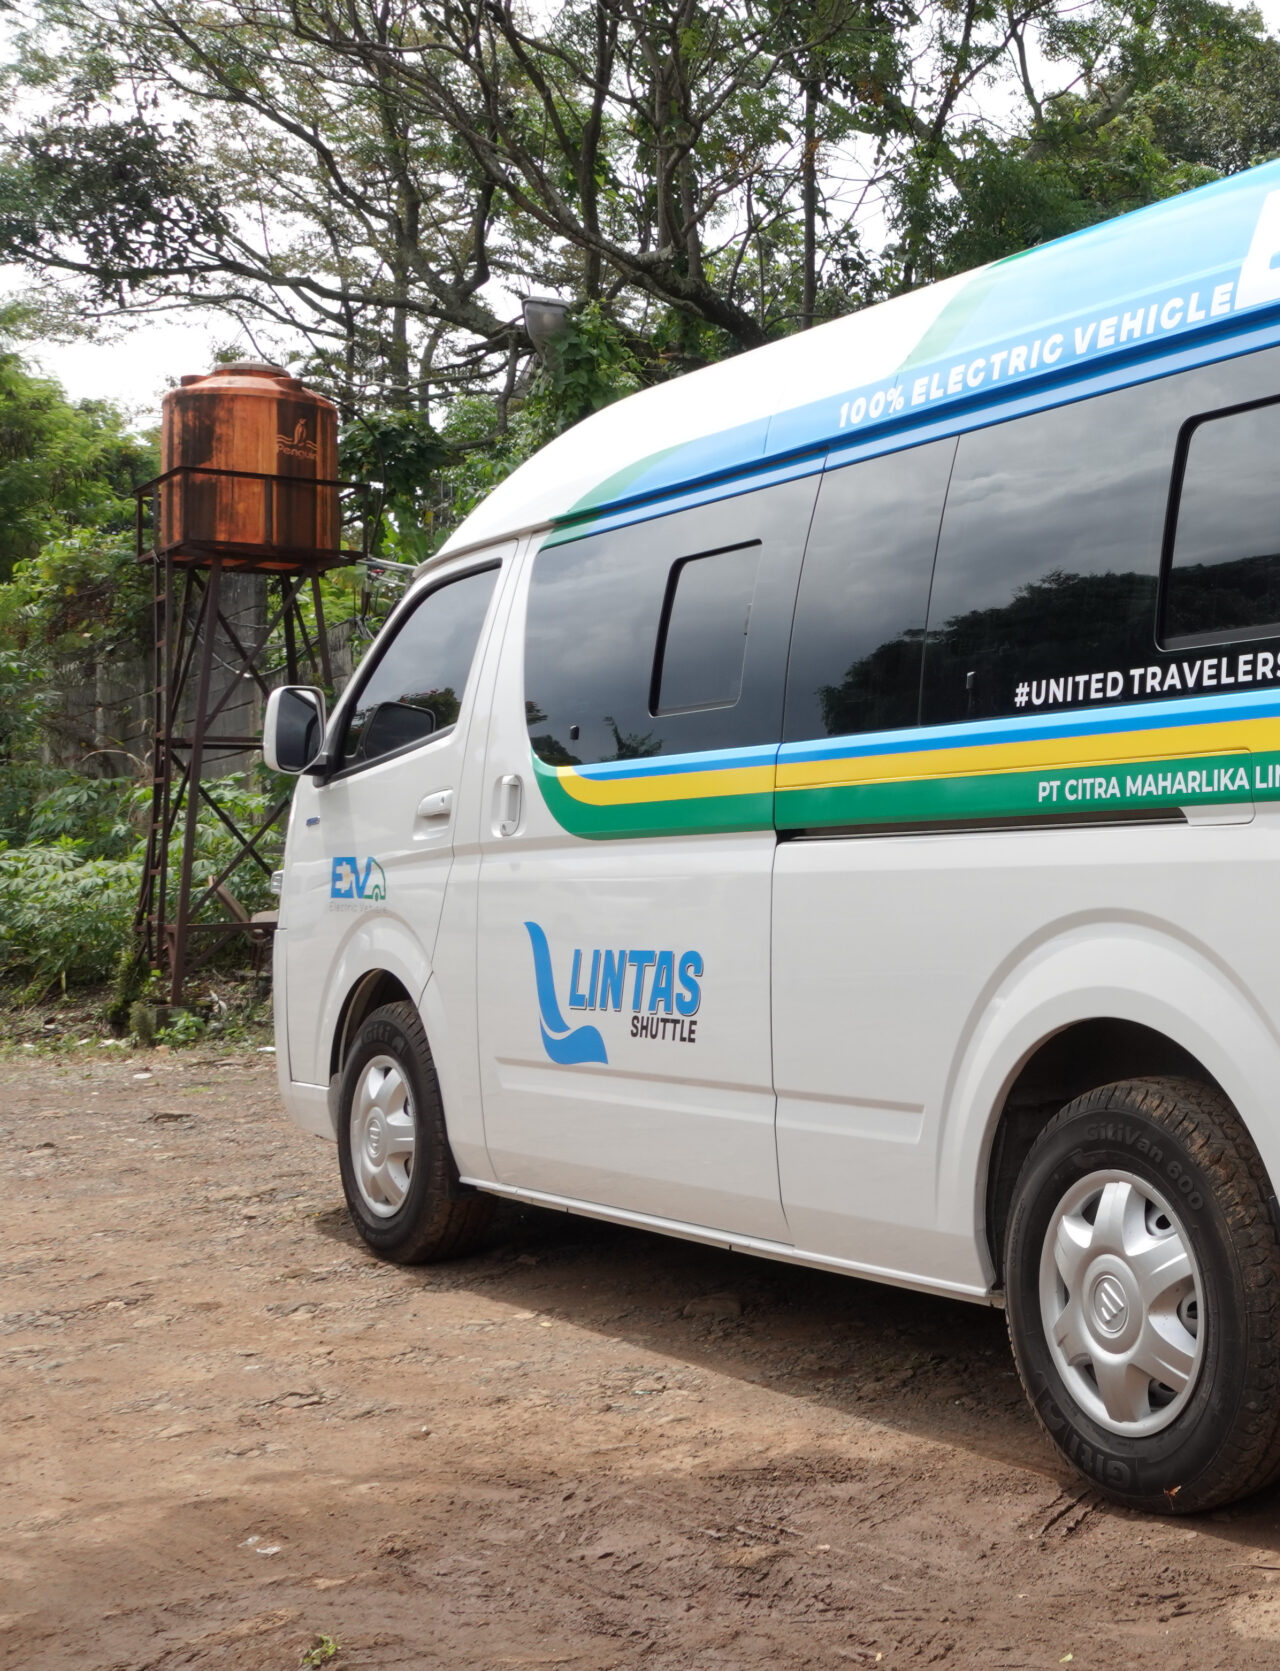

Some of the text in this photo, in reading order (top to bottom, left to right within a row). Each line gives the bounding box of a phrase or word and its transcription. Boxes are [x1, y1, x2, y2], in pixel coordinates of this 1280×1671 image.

[839, 282, 1234, 428] 100% ELECTRIC VEHICLE
[1015, 671, 1123, 707] #UNITED
[1038, 780, 1061, 803] PT
[1065, 775, 1120, 801] CITRA
[1126, 767, 1249, 797] MAHARLIKA
[331, 856, 374, 898] EV
[568, 949, 704, 1016] LINTAS
[630, 1015, 697, 1043] SHUTTLE
